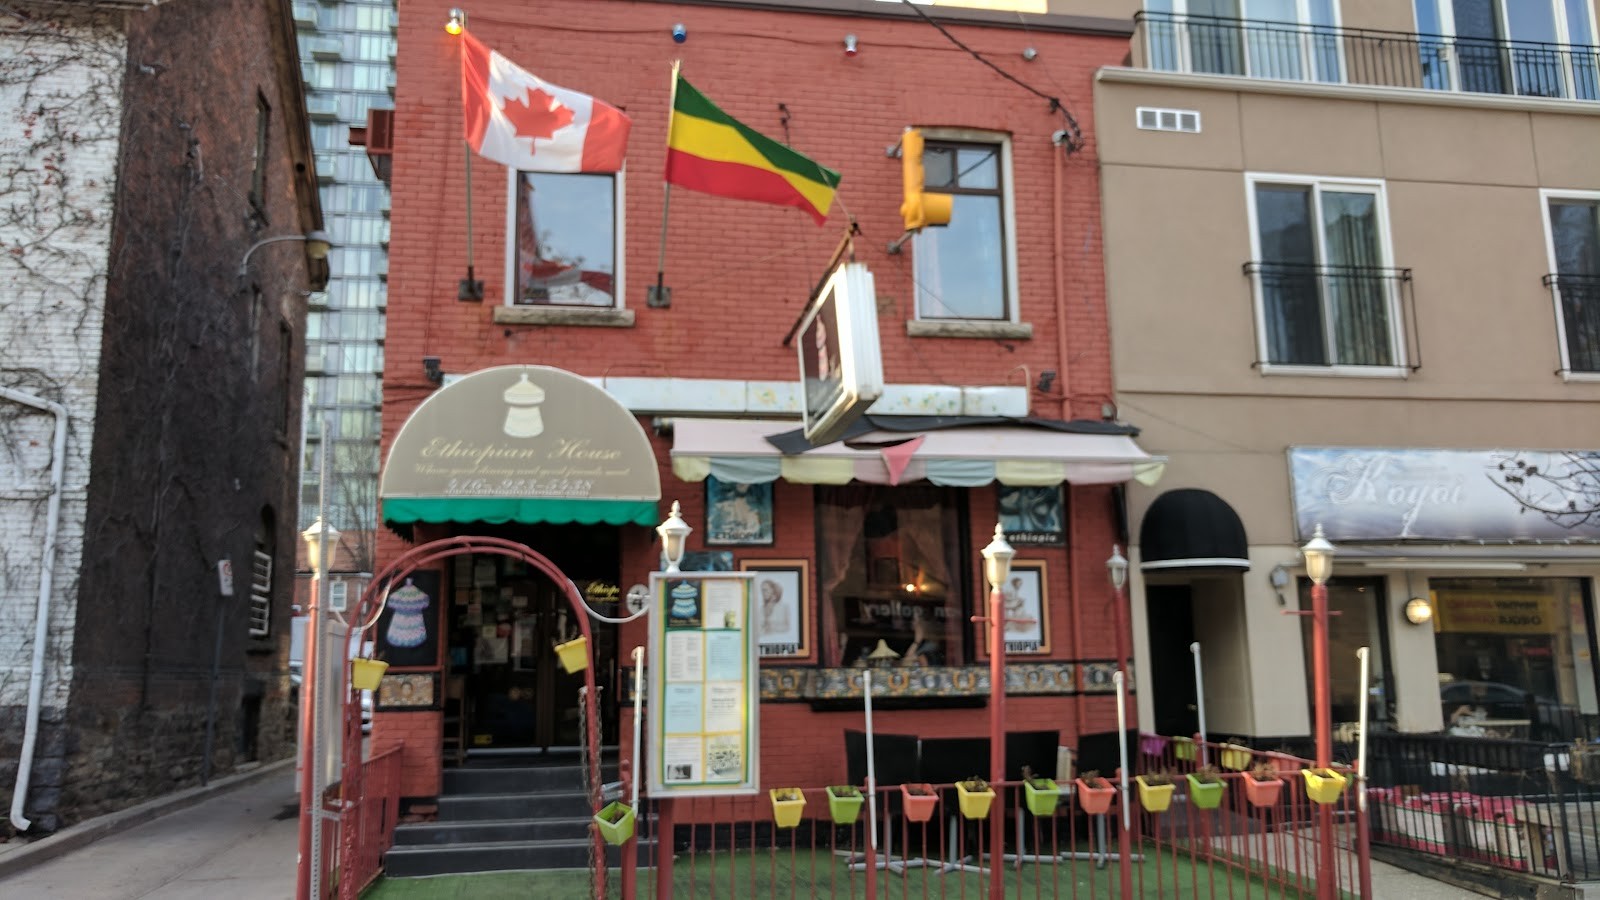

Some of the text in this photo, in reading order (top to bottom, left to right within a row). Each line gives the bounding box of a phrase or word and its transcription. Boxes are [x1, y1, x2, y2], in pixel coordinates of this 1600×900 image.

[421, 437, 622, 464] Ethiopian House
[1009, 533, 1056, 543] ethiopia
[758, 643, 797, 655] THIOPIA
